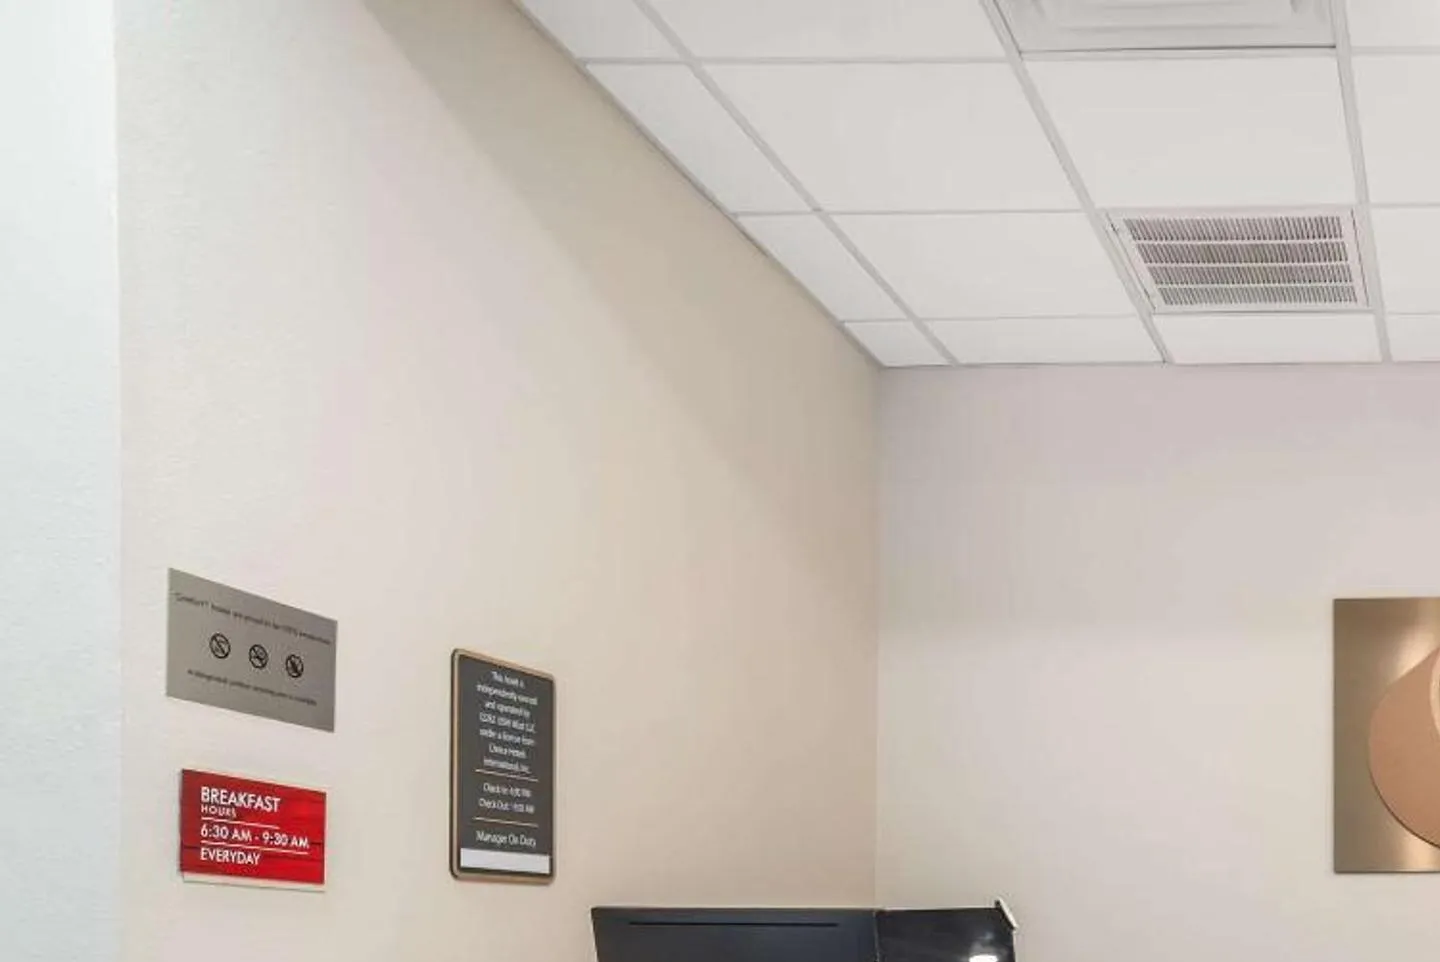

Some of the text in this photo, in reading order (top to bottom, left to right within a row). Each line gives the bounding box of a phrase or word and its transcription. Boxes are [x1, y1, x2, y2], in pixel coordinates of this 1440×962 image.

[201, 787, 280, 812] BREAKFAST
[200, 804, 236, 817] HOURS
[200, 824, 229, 839] 6:30
[231, 829, 252, 842] AM
[262, 833, 288, 846] 9:30
[290, 836, 310, 849] AM
[476, 830, 507, 846] Manager
[200, 847, 261, 865] EVERYDAY
